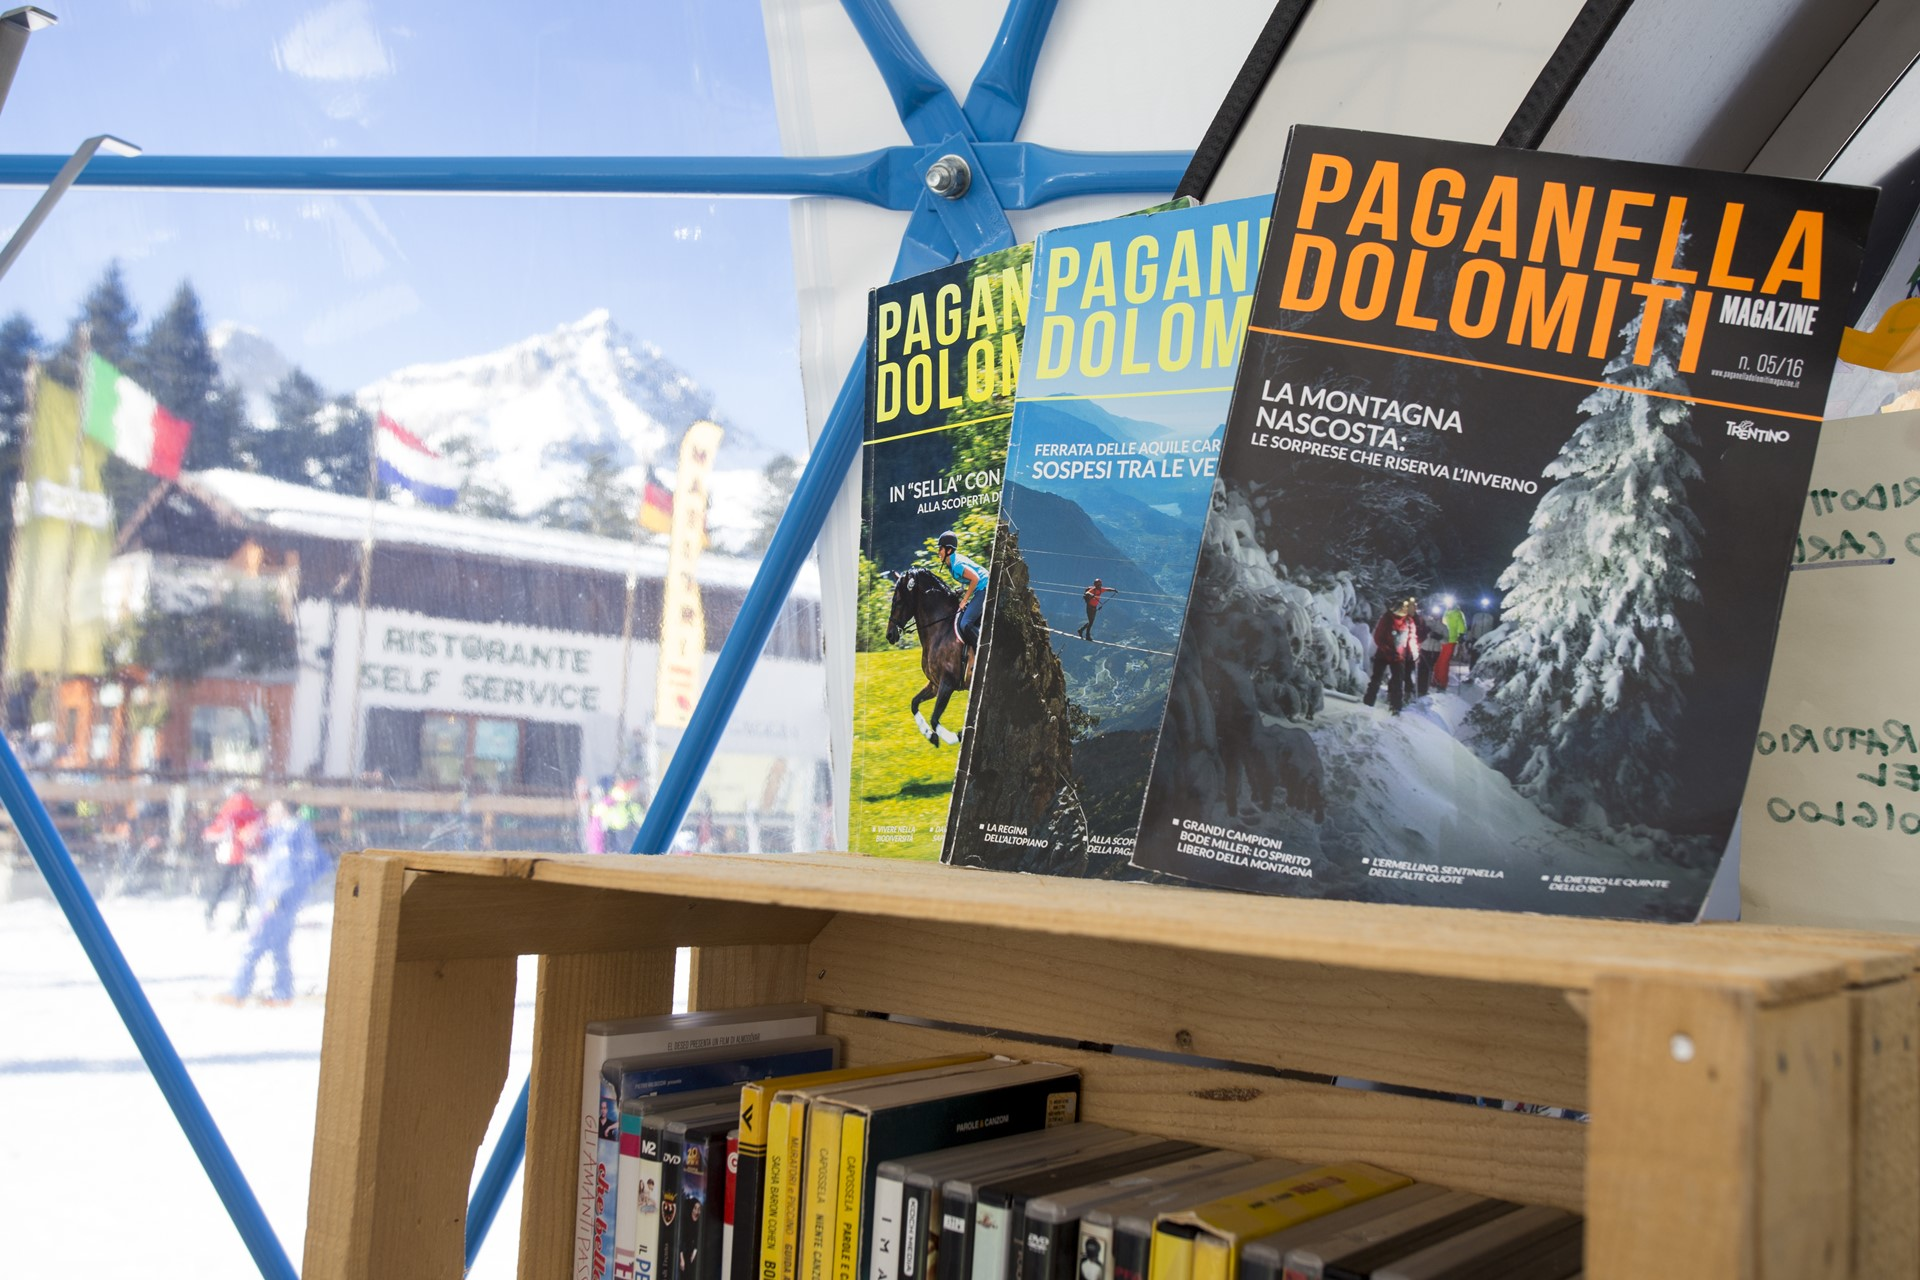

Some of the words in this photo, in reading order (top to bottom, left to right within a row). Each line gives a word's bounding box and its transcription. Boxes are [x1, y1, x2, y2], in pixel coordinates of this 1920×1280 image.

[1297, 153, 1823, 300] PAGANELLA
[1045, 217, 1271, 312] PAGAN
[878, 262, 1032, 362] PAGAN
[1279, 233, 1713, 373] DOLOMITI
[1719, 295, 1819, 335] MAGAZINE
[1738, 356, 1750, 370] n.
[1757, 354, 1804, 378] 05/16
[1261, 380, 1294, 405] LA
[1300, 386, 1463, 433] MONTAGNA
[1255, 406, 1405, 451] NASCOSTA:
[1034, 443, 1093, 456] FERRATA
[1096, 442, 1136, 456] DELLE
[1139, 440, 1189, 456] AQUILE
[1251, 432, 1268, 447] LE
[1270, 435, 1348, 461] SORPRESE
[1350, 450, 1383, 467] CHE
[1385, 456, 1450, 479] RISERVA
[1452, 467, 1538, 495] L’INVERNO
[1031, 460, 1111, 480] SOSPESI
[1117, 459, 1156, 478] TRA
[1161, 458, 1184, 478] LE
[1189, 457, 1219, 477] VE
[889, 485, 905, 503] IN
[965, 469, 1000, 490] CON
[917, 501, 940, 514] ALLA
[941, 493, 990, 510] SCOPERTA
[384, 626, 592, 673] RISTORANTE
[360, 663, 440, 693] SELF
[462, 674, 600, 711] SERVICE
[986, 823, 997, 832] LA
[998, 825, 1028, 836] REGINA
[1090, 835, 1111, 845] ALLA
[1183, 819, 1225, 837] GRANDI
[1226, 830, 1282, 850] CAMPIONI
[1087, 845, 1111, 855] DELLA
[1177, 842, 1215, 859] LIBERO
[1216, 852, 1249, 867] DELLA
[1250, 859, 1312, 878] MONTAGNA
[1180, 831, 1210, 846] BODE
[1211, 838, 1252, 856] MILLER:
[1253, 848, 1268, 859] LO
[1269, 851, 1311, 867] SPIRITO
[1368, 868, 1399, 879] DELLE
[1400, 871, 1425, 881] ALTE
[1425, 874, 1465, 885] QUOTE
[1440, 866, 1504, 879] SENTINELLA
[1608, 878, 1621, 886] LE
[1622, 878, 1670, 888] QUINTE
[719, 1036, 730, 1045] FILM
[585, 1115, 598, 1146] GLI
[956, 1121, 979, 1133] PAROLE
[985, 1114, 1009, 1127] CANZONI
[641, 1139, 657, 1156] M2
[662, 1153, 682, 1166] DVD
[788, 1137, 800, 1185] MURATORI
[770, 1155, 781, 1185] SACHA
[816, 1148, 829, 1204] CAPOSSELA
[844, 1155, 856, 1212] CAPOSSELA
[580, 1156, 598, 1233] AMANTI
[595, 1162, 611, 1214] che
[768, 1186, 780, 1218] BARON
[785, 1193, 796, 1235] PICCINO
[767, 1219, 778, 1250] COHEN
[814, 1213, 824, 1249] NIENTE
[841, 1222, 852, 1260] PAROLE
[638, 1244, 648, 1255] IL
[783, 1243, 793, 1273] GUIDA
[841, 1262, 850, 1270] E
[905, 1236, 915, 1272] MEDIA
